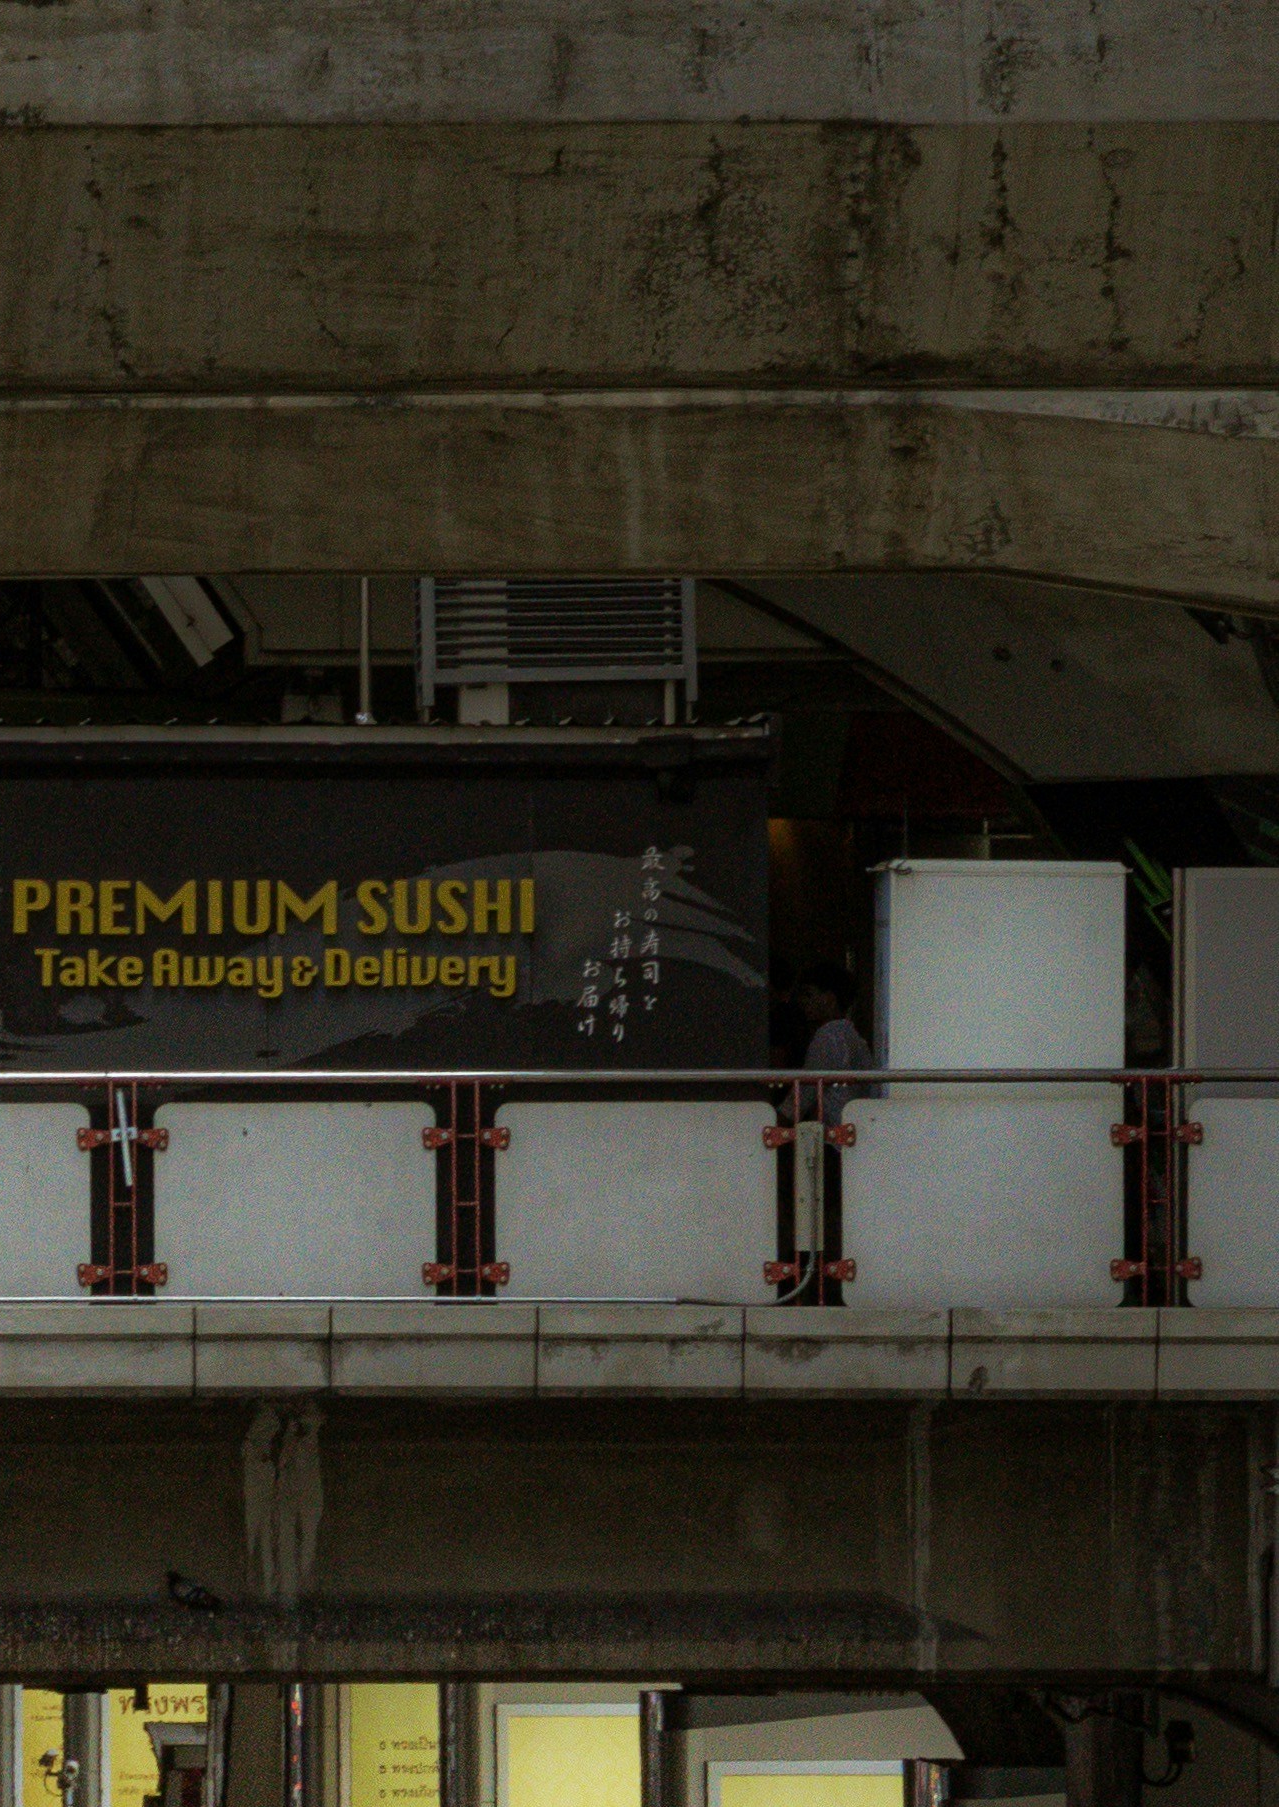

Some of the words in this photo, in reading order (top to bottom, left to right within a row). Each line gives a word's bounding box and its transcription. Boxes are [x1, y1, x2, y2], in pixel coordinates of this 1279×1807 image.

[12, 879, 339, 936] PREMIUM
[356, 878, 535, 936] SUSHI
[34, 947, 144, 988] Take
[152, 947, 284, 999] Away
[290, 957, 319, 988] &
[324, 947, 518, 999] Delivery
